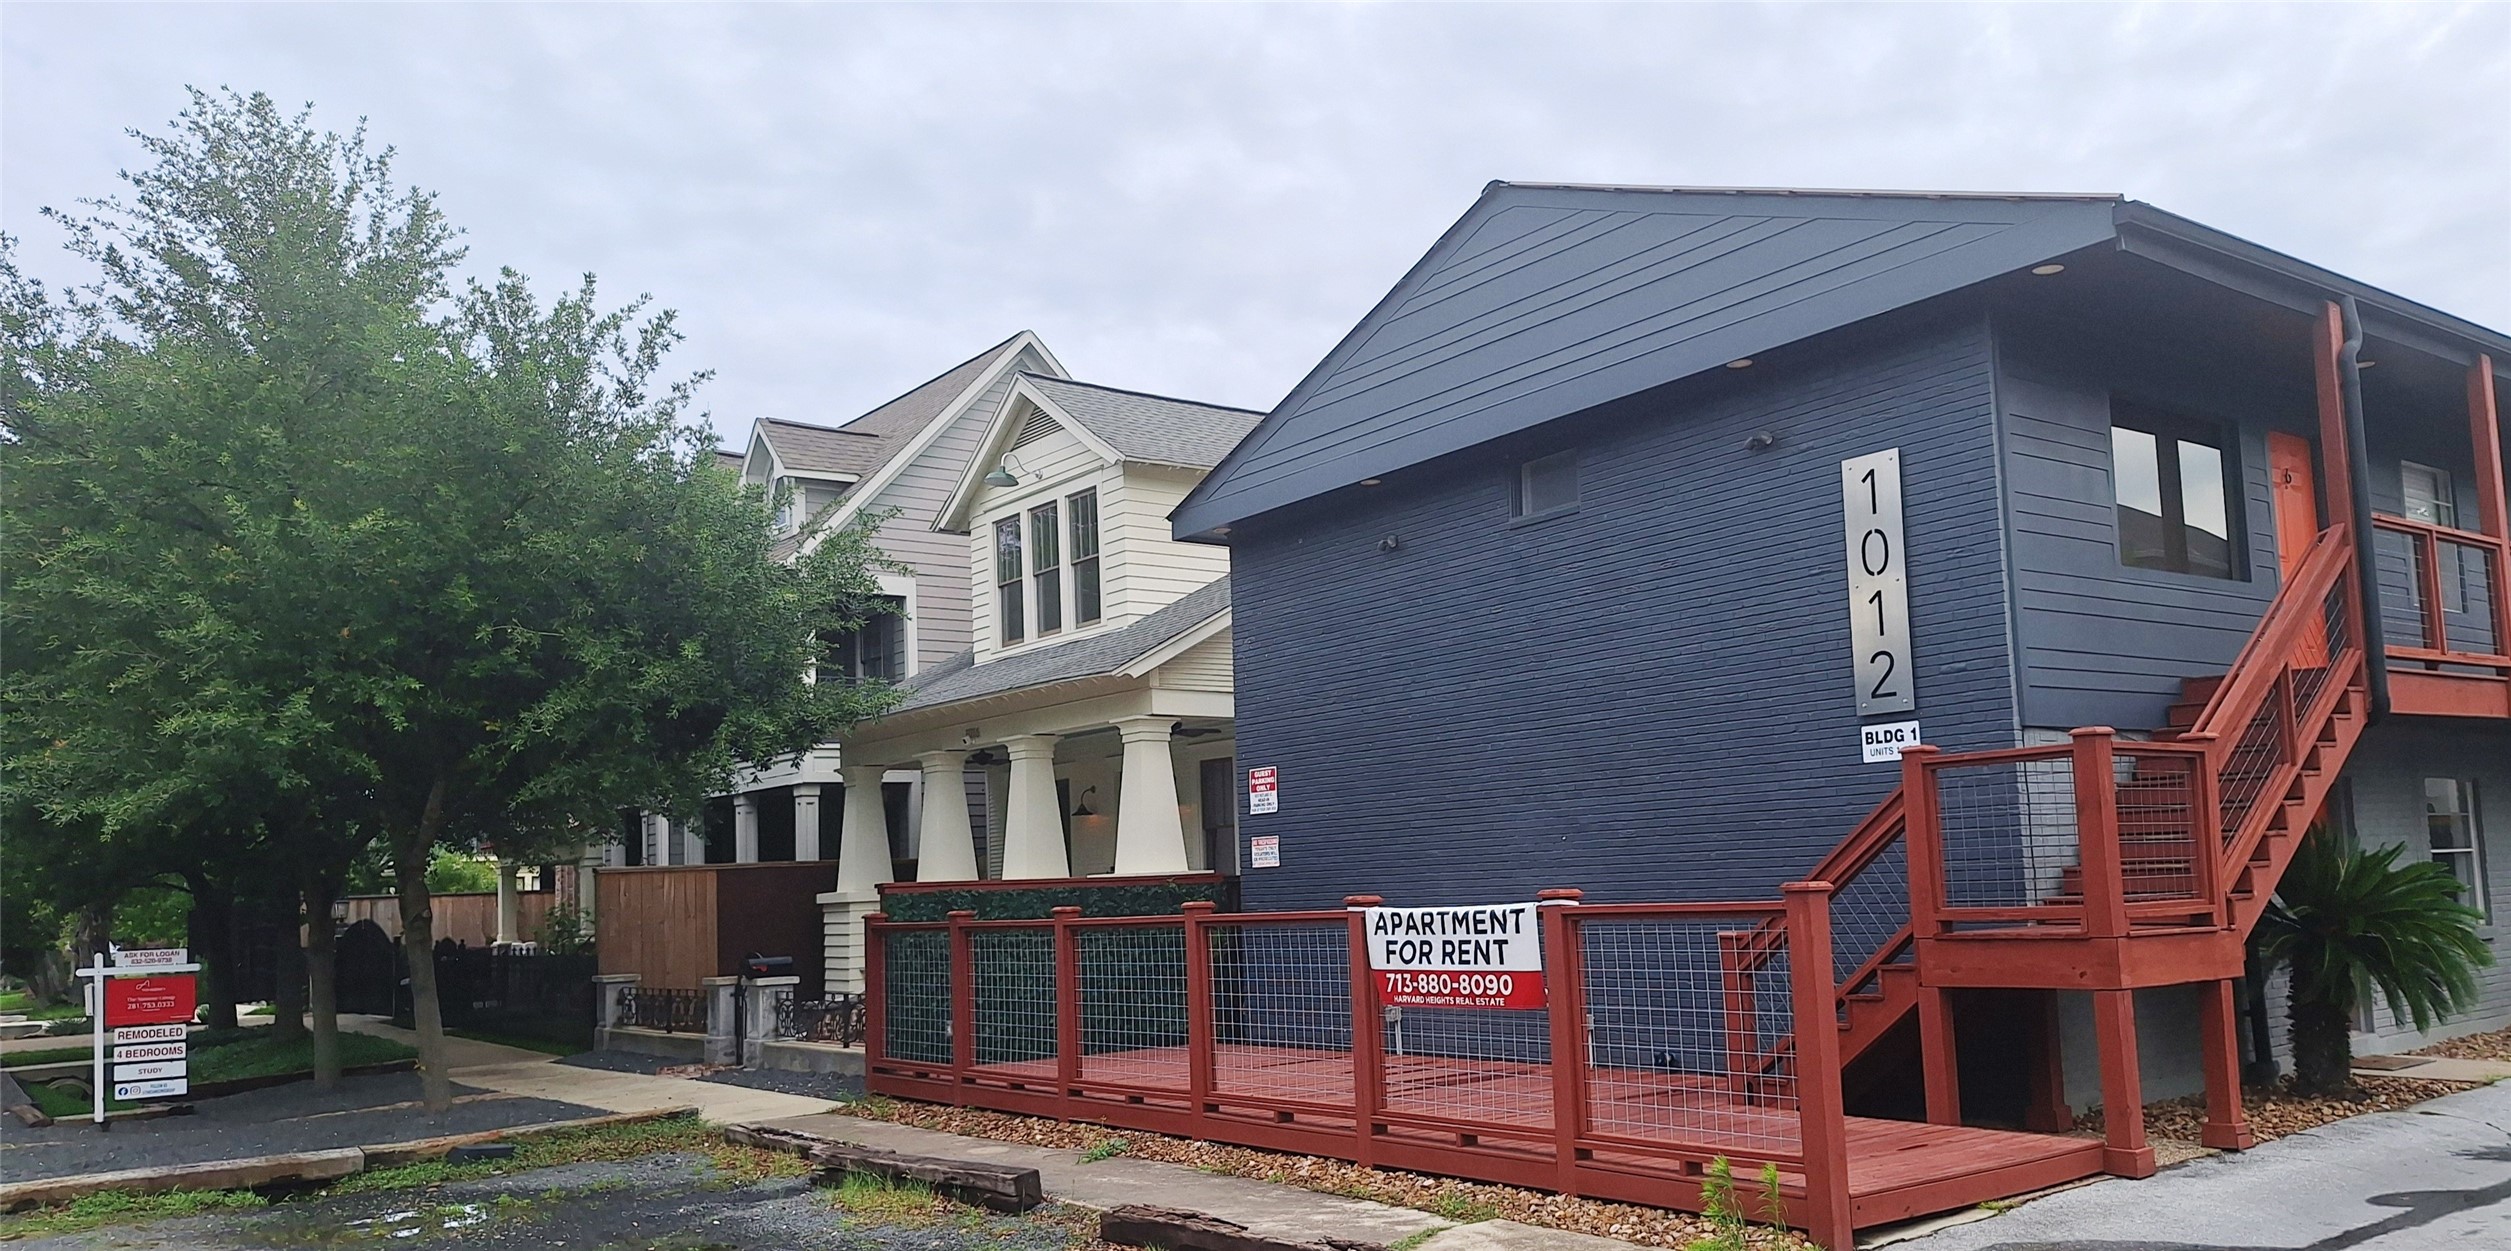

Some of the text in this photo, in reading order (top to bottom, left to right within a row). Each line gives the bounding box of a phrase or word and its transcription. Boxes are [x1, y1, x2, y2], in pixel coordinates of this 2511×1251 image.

[1861, 468, 1898, 699] 1012
[1865, 727, 1917, 745] BLDG 1
[1870, 746, 1894, 757] UNITS
[1254, 769, 1272, 778] GUEST
[1251, 776, 1275, 785] PARKING
[1256, 784, 1271, 792] ONLY
[1374, 908, 1526, 936] APARTMENT
[1385, 939, 1509, 965] FOR RENT
[1385, 973, 1513, 996] 713-880-8090
[1393, 995, 1505, 1007] HARVARD HEIGHTS REAL ESTATE
[118, 1027, 183, 1040] REMODELED
[117, 1046, 183, 1059] 4 BEDROOMS
[138, 1067, 163, 1075] STUDY
